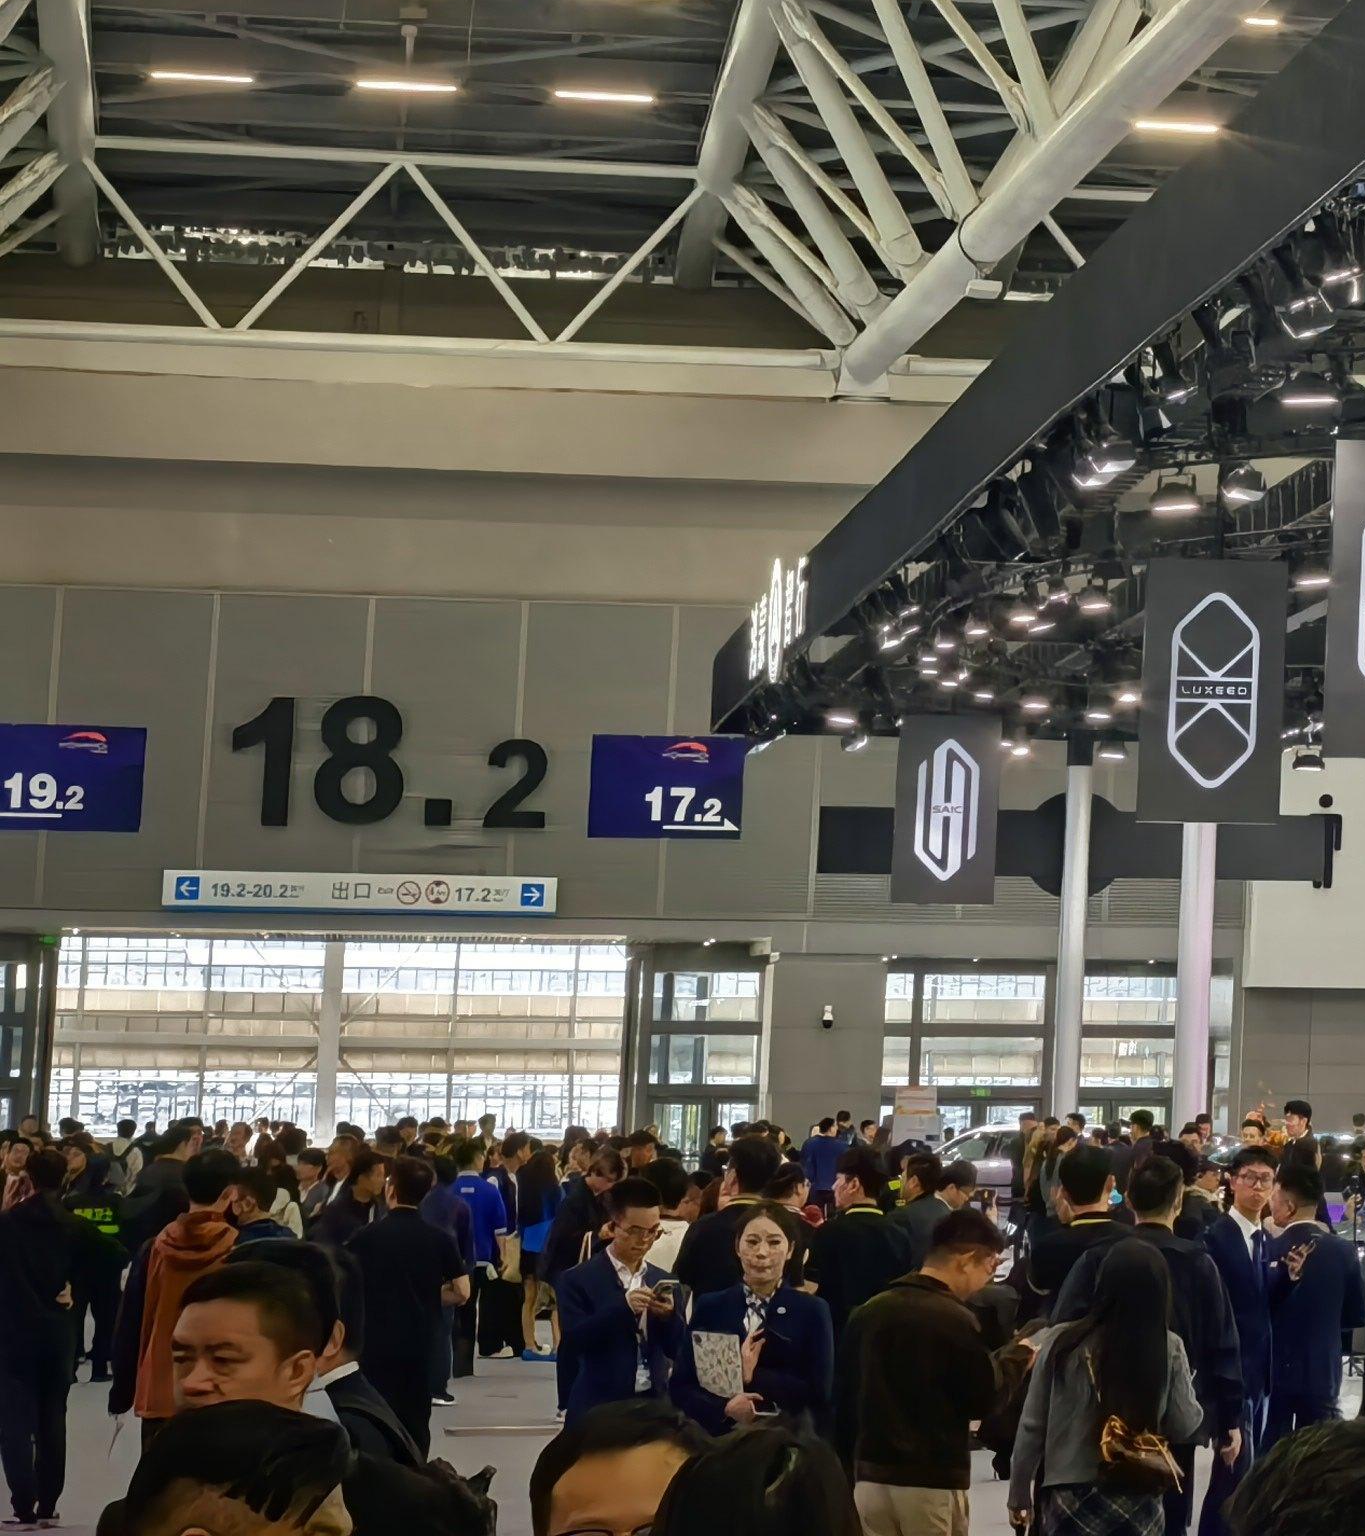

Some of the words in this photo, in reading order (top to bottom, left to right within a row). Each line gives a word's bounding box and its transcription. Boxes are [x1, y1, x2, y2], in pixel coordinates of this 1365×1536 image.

[231, 695, 548, 828] 18.2
[4, 772, 84, 810] 19.2
[645, 786, 722, 822] 17.2
[211, 882, 289, 898] 19.2-20.2
[331, 881, 371, 900] 出口
[455, 887, 491, 902] 17.2
